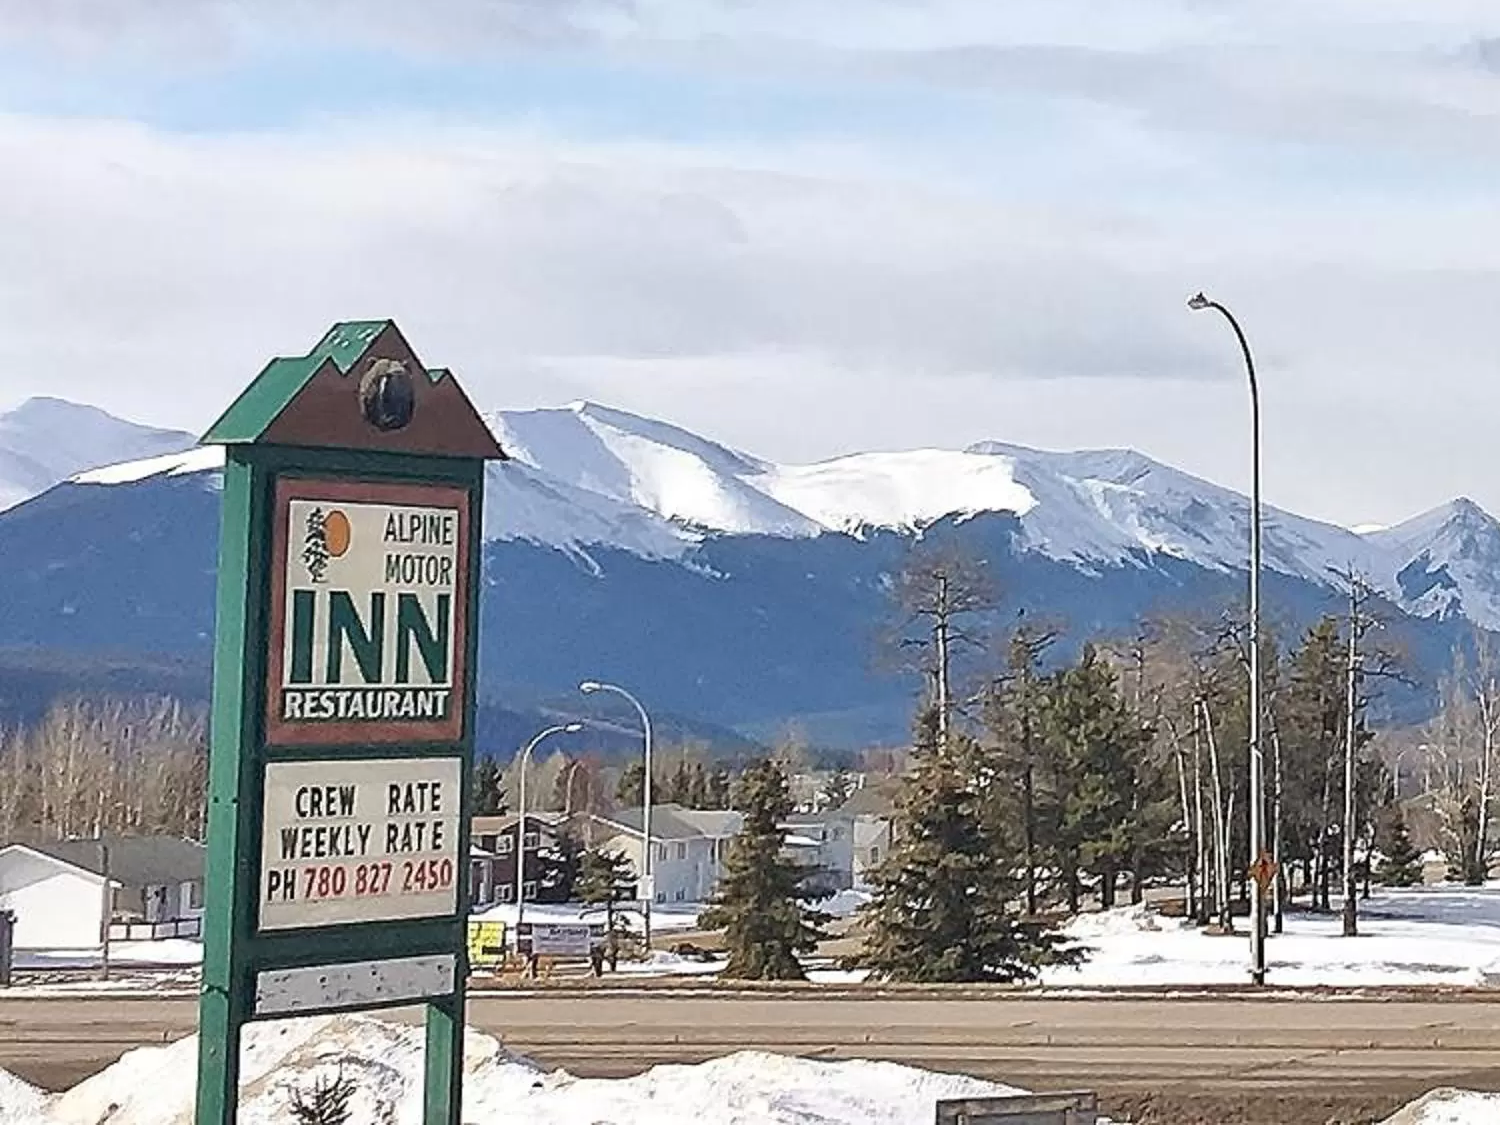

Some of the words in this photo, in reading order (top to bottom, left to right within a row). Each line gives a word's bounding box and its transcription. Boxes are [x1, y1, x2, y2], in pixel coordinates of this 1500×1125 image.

[384, 513, 453, 545] ALPINE
[384, 554, 451, 584] MOTOR
[290, 590, 450, 683] INN
[284, 690, 449, 719] RESTAURANT
[296, 785, 355, 818] CREW
[388, 783, 441, 814] RATE
[281, 824, 371, 860] WEEKLY
[386, 821, 443, 853] RATE
[267, 868, 297, 901] PH
[304, 866, 346, 898] 780
[355, 863, 392, 894] 827
[402, 858, 452, 890] 2450
